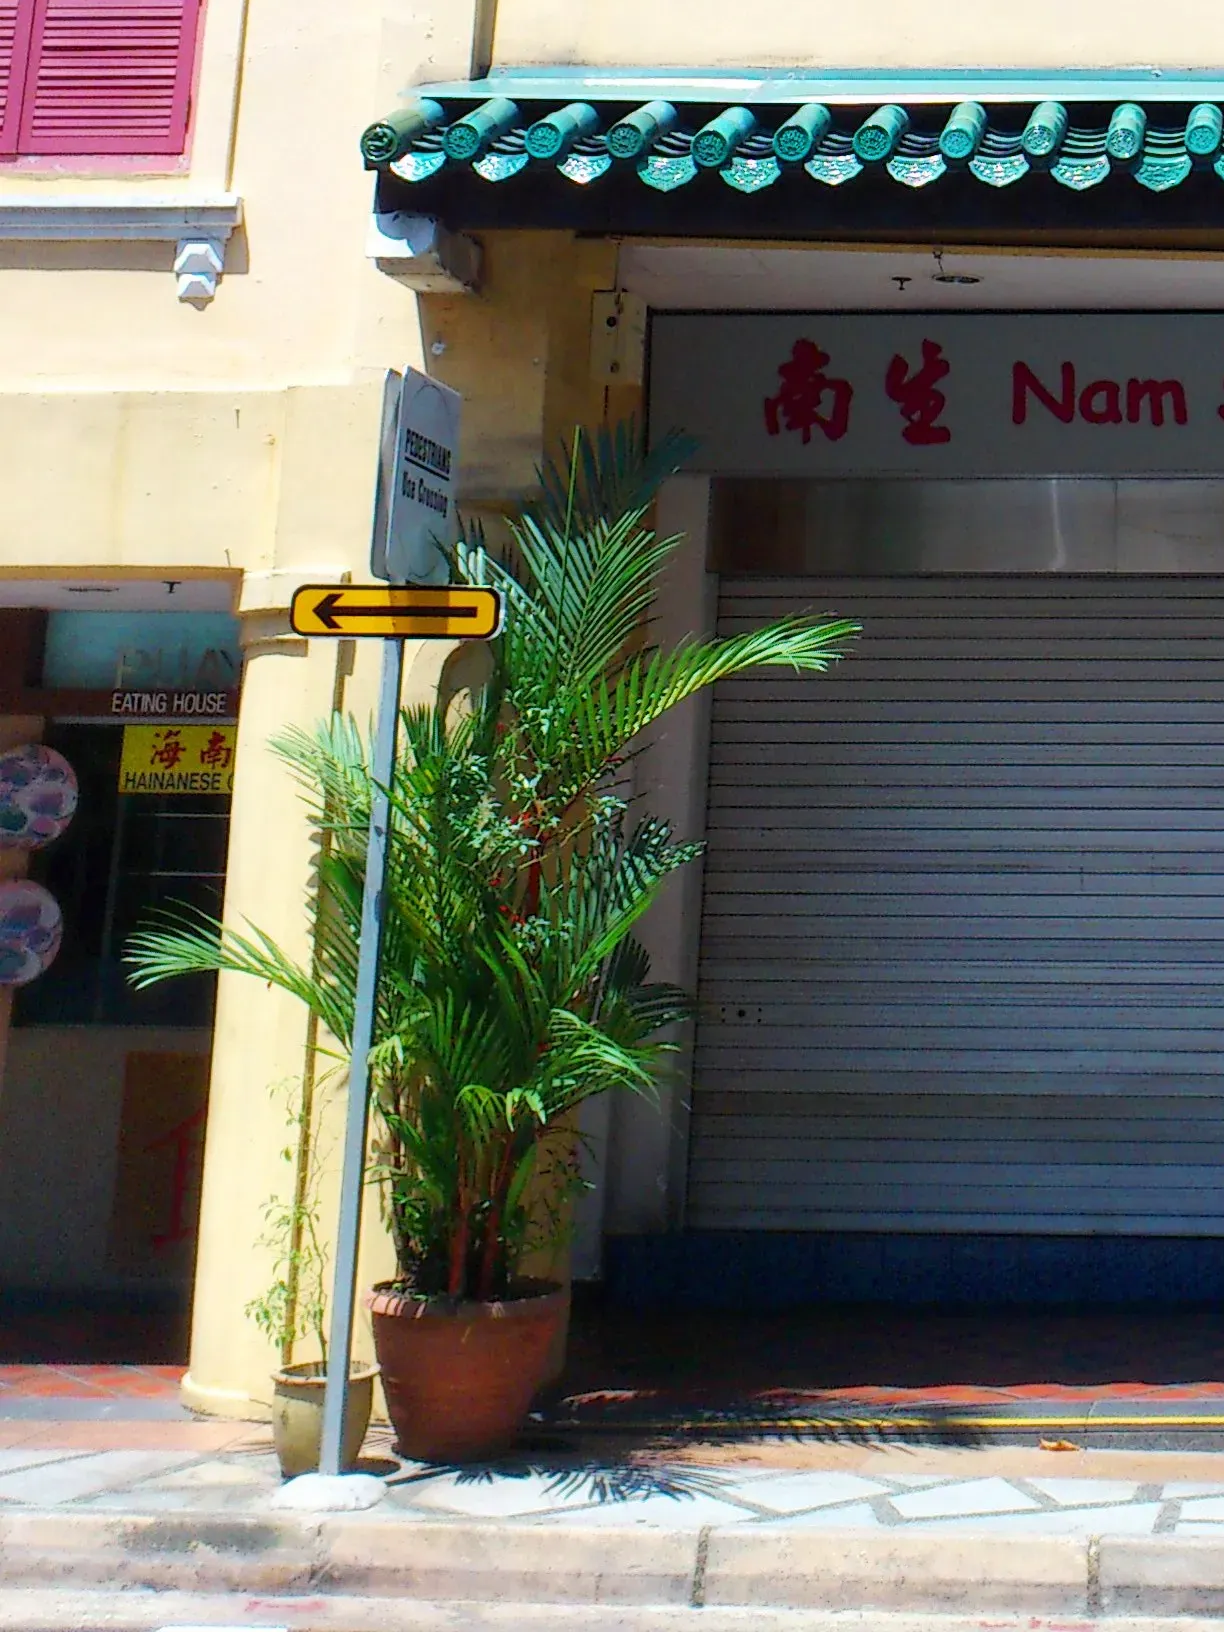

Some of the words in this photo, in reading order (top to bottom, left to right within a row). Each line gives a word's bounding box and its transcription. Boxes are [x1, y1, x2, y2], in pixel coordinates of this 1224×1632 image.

[764, 339, 951, 445] 南生
[1012, 361, 1187, 426] Nam
[405, 428, 451, 474] PEDESTRIANS
[111, 693, 167, 713] EATING
[172, 693, 227, 713] HOUSE
[124, 772, 222, 791] HAINANESE
